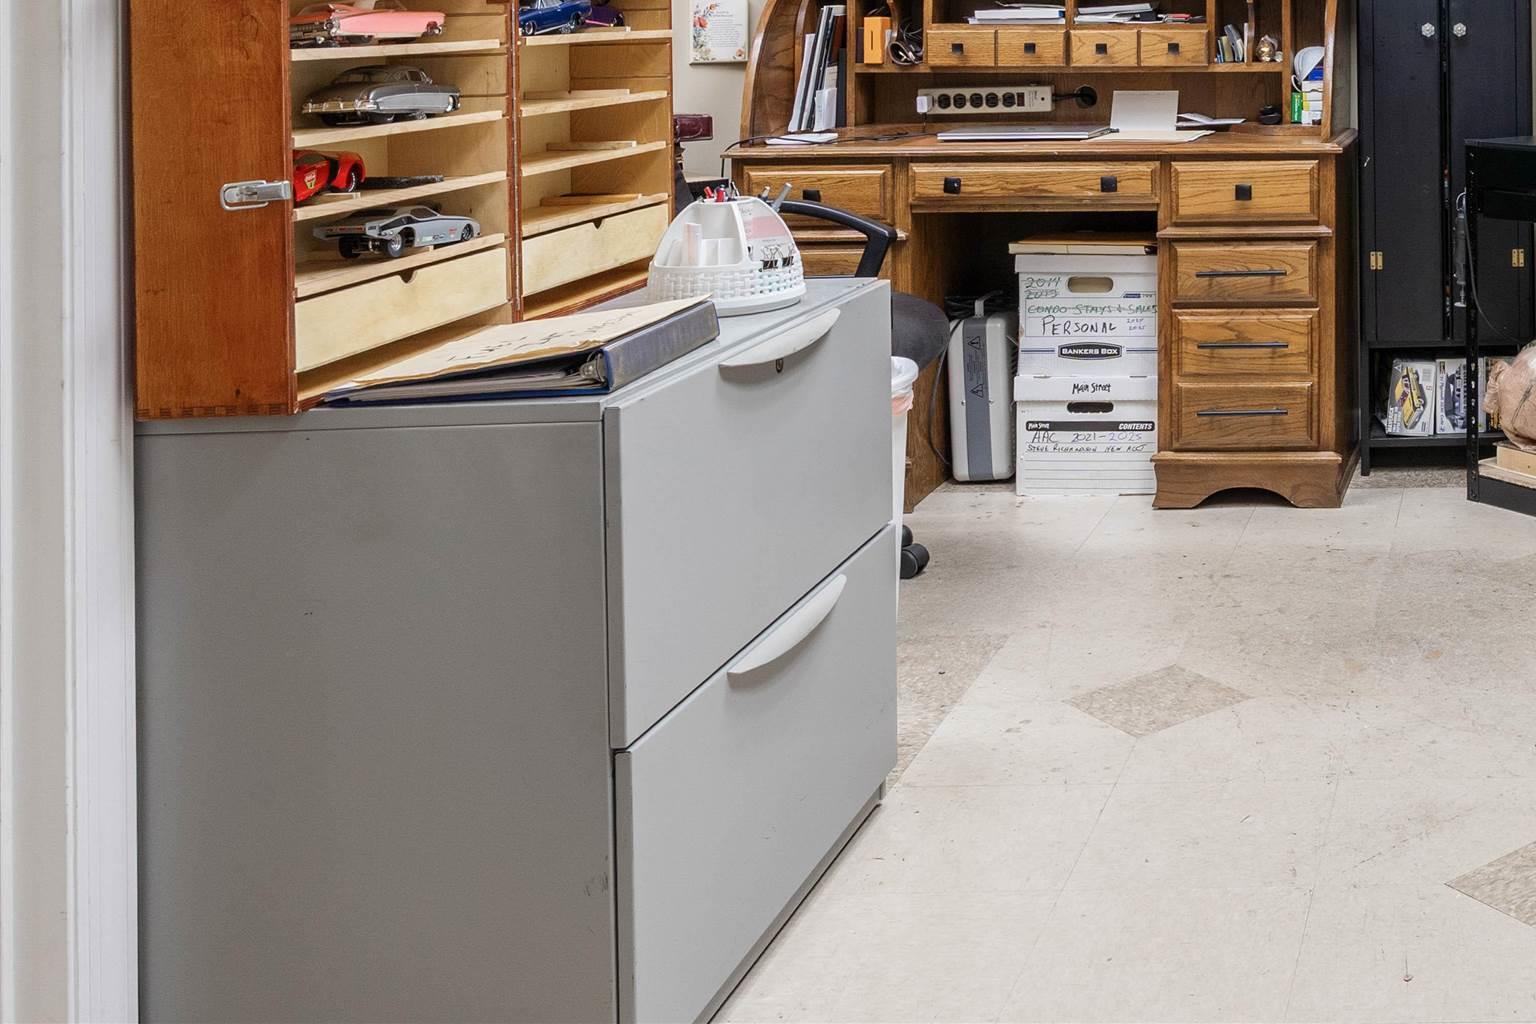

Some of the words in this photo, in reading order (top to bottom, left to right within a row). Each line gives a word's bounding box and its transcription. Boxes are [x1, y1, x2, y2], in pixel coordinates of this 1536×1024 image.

[1042, 315, 1118, 336] PERSONAL
[1072, 383, 1090, 394] Main
[1091, 383, 1111, 393] Street
